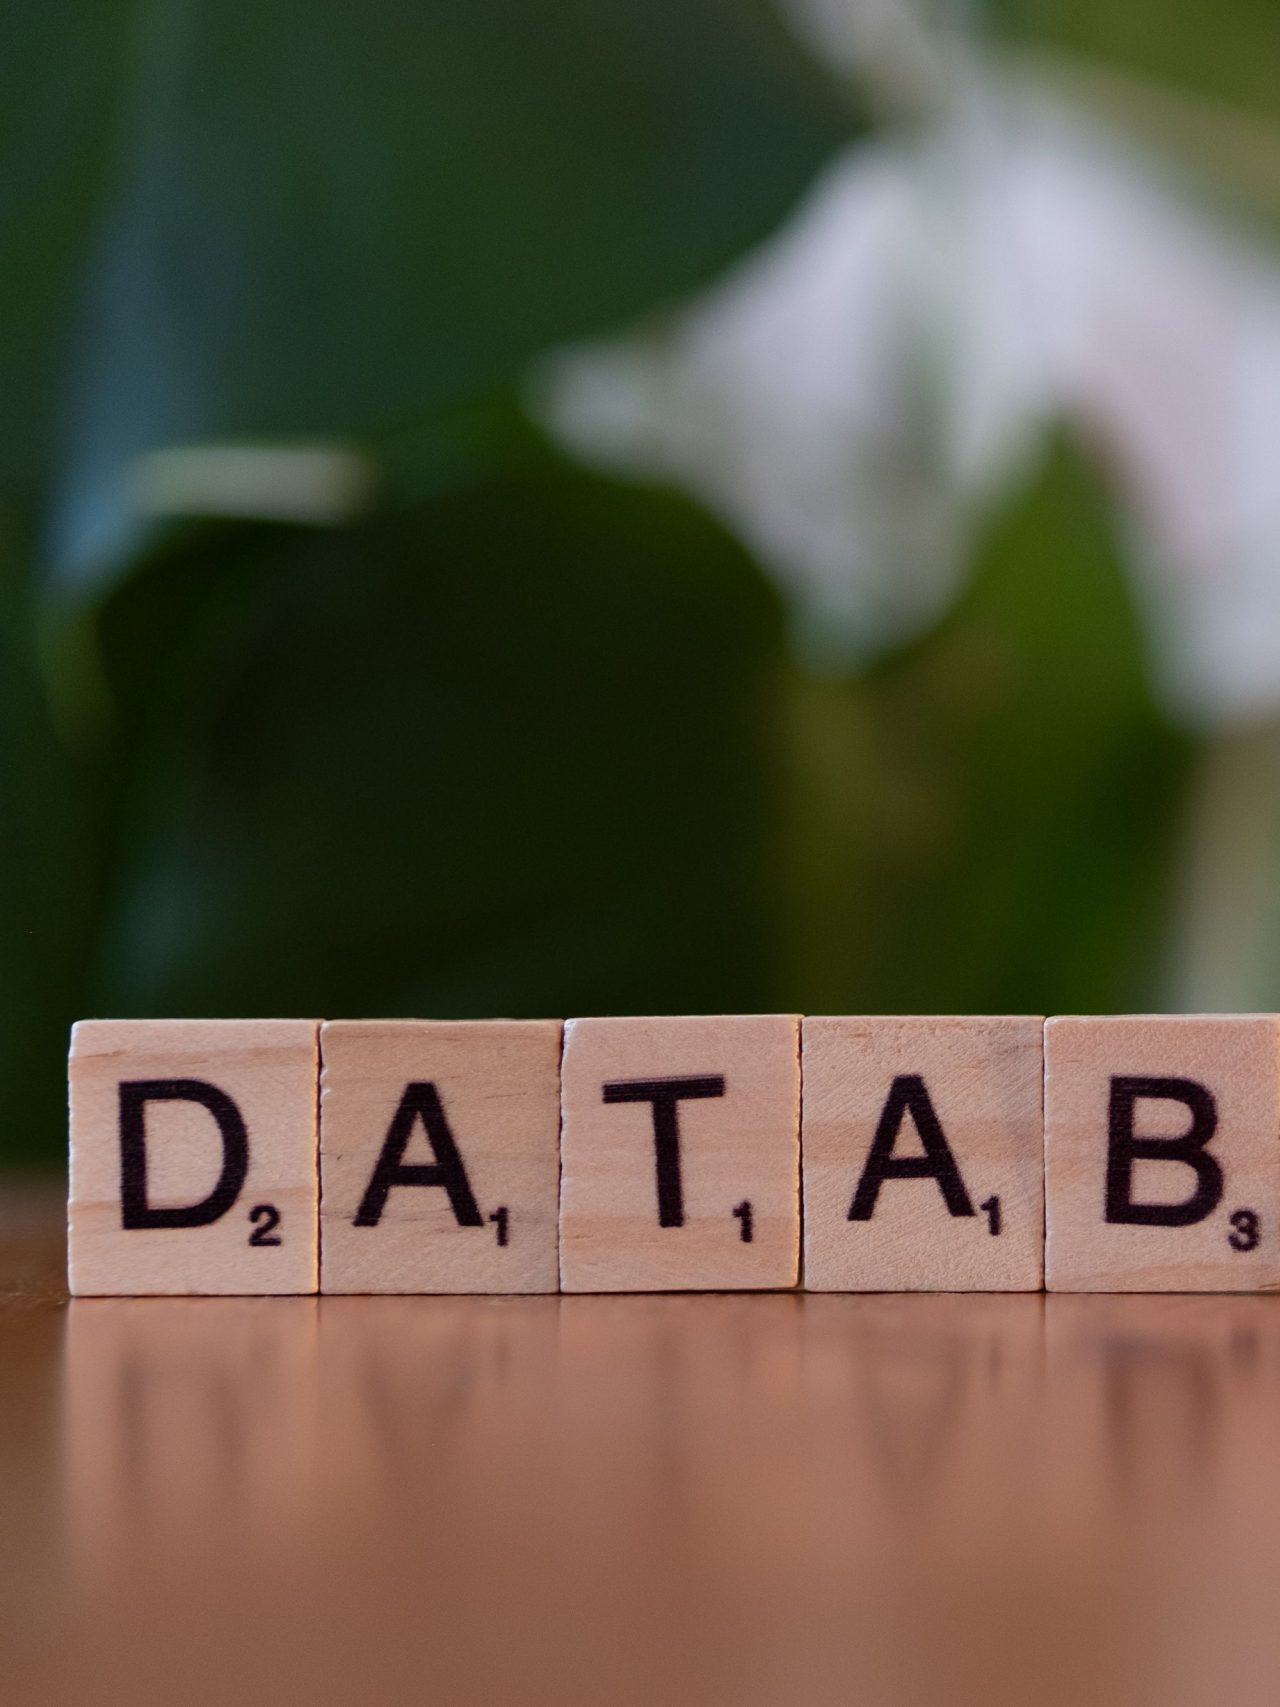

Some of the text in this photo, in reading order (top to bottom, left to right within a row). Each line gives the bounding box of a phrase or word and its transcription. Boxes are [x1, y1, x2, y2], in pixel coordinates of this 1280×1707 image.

[249, 1205, 281, 1246] 2
[487, 1206, 510, 1247] 1
[732, 1201, 754, 1243] 1
[980, 1195, 1002, 1237] 1
[1229, 1209, 1260, 1252] 3
